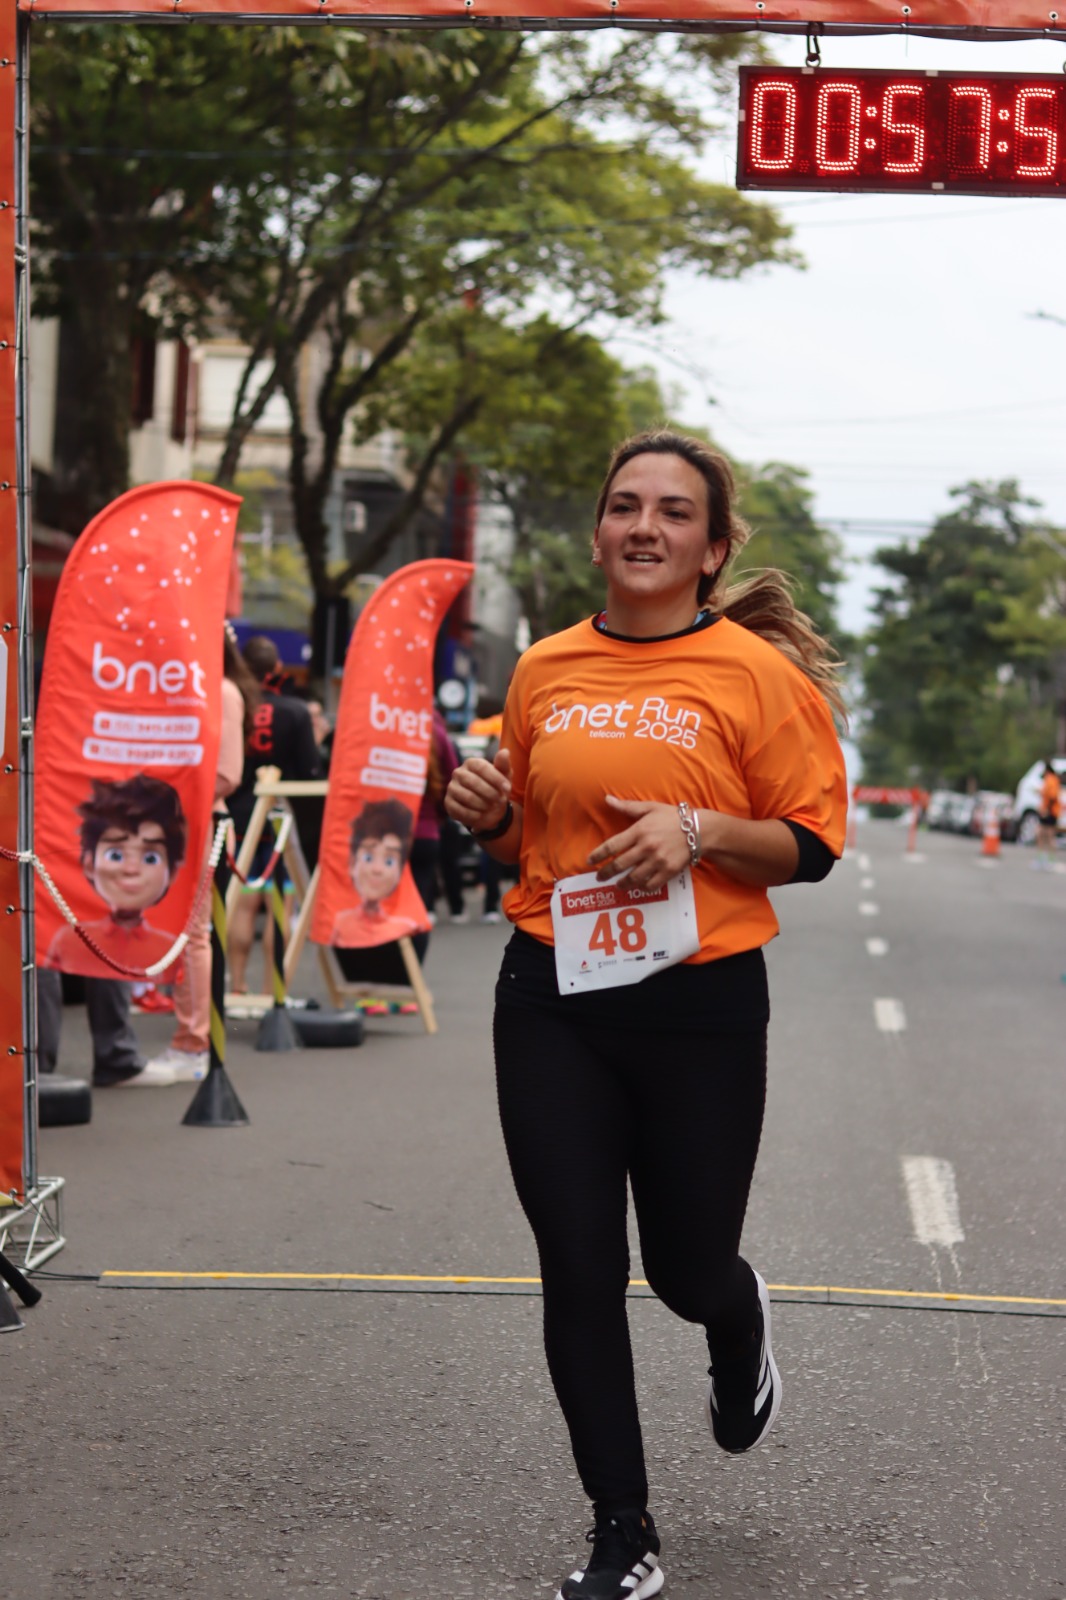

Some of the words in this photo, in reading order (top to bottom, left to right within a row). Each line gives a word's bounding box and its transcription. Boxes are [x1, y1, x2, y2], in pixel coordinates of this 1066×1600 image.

[92, 641, 207, 698] bnet
[369, 691, 433, 741] bnet
[545, 700, 634, 733] bnet
[638, 696, 702, 732] Run
[589, 730, 626, 739] telecom
[633, 717, 698, 750] 2025
[565, 892, 596, 909] bnet
[595, 890, 616, 902] Run
[588, 908, 647, 956] 48
